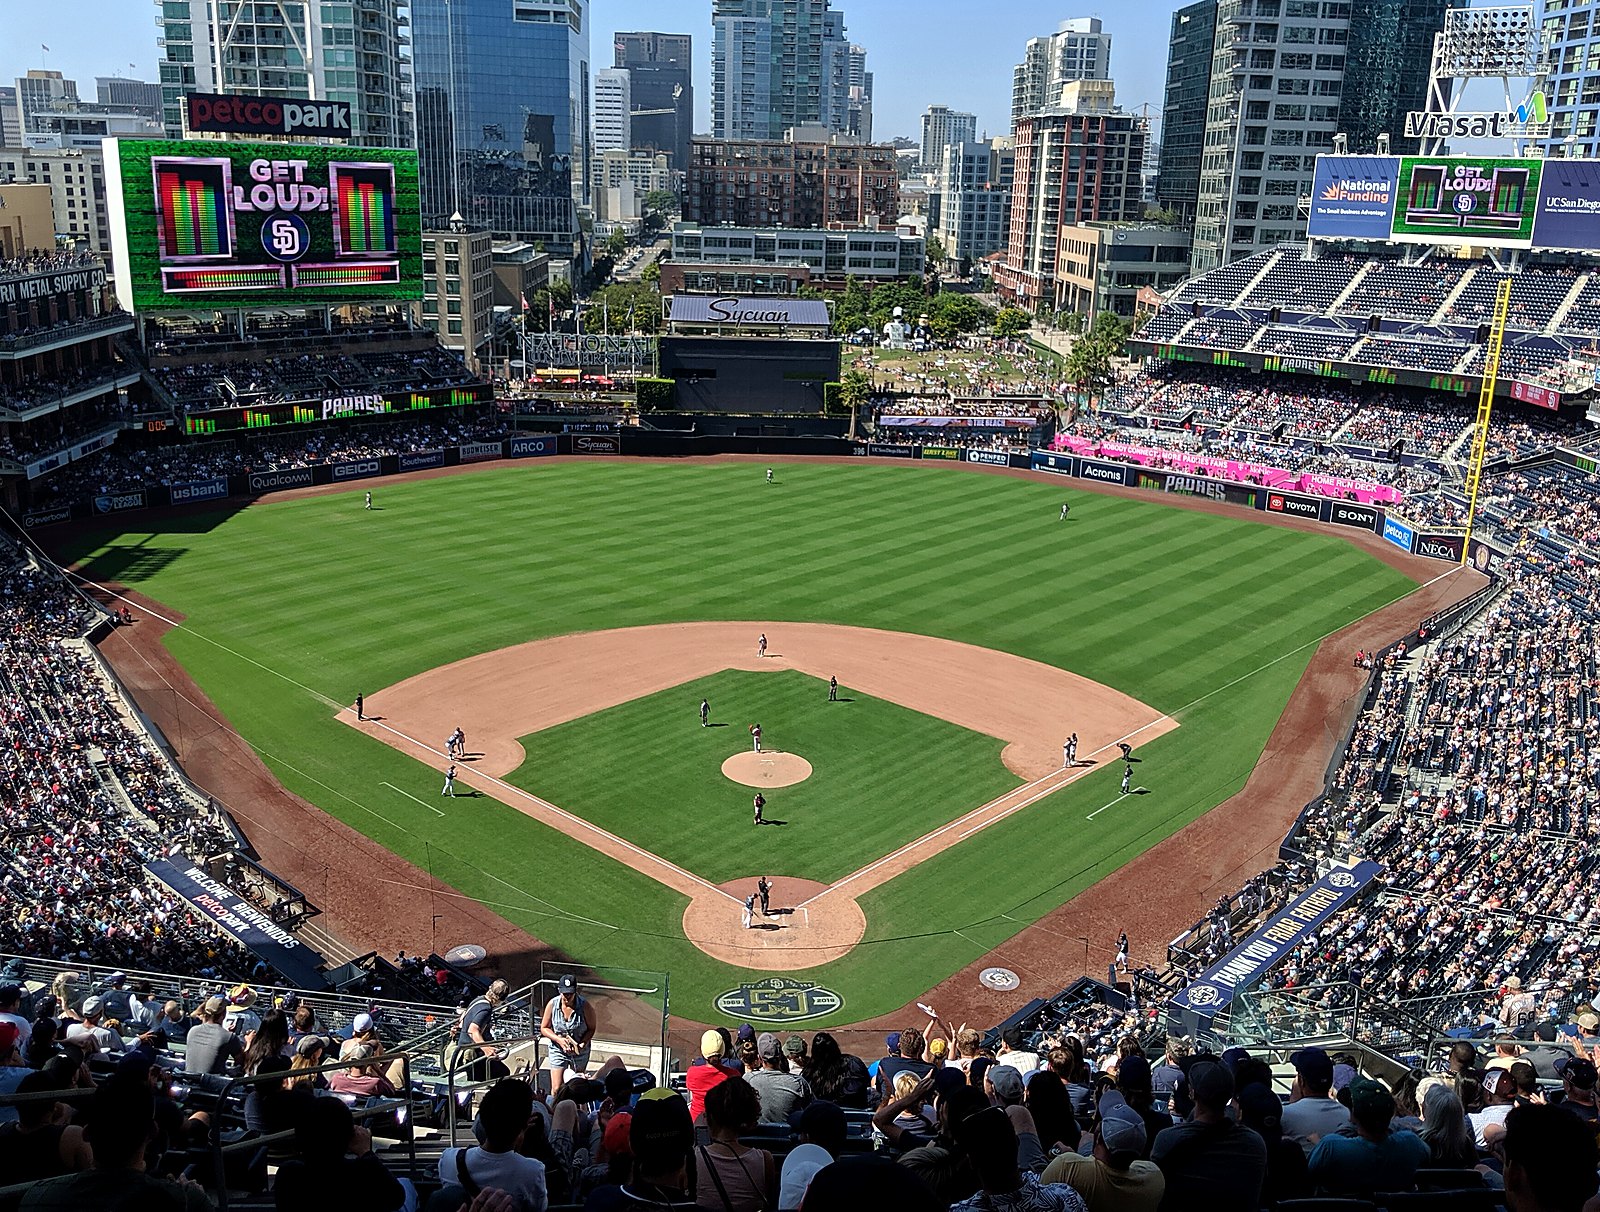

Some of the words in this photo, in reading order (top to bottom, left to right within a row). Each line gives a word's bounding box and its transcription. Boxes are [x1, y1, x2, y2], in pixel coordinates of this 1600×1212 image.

[1410, 112, 1503, 138] Viasat
[250, 159, 308, 182] GET
[1454, 165, 1484, 178] GET
[1340, 179, 1391, 192] National
[233, 183, 330, 211] LOUD!
[1339, 191, 1389, 203] Funding
[1560, 197, 1576, 208] San
[1576, 197, 1600, 210] Diego
[1360, 209, 1387, 217] Advantage
[19, 278, 53, 300] METAL
[53, 271, 89, 293] SUPPLY
[90, 269, 107, 286] CO.
[707, 297, 791, 328] Sycuan
[516, 331, 656, 354] NATIONAL
[528, 350, 647, 366] UNIVERSITY
[1282, 358, 1320, 371] PADRES
[322, 394, 385, 420] PADRES
[462, 443, 499, 456] BUDWEISER
[512, 441, 545, 454] ARCO
[577, 437, 613, 451] Sycuan
[853, 446, 866, 456] 396
[402, 455, 437, 467] Southwest
[979, 452, 1007, 462] PENFED
[1103, 442, 1127, 453] NOBODY
[1161, 451, 1181, 462] MORE
[1208, 459, 1228, 469] FANS
[334, 461, 379, 477] GEICO
[1084, 465, 1121, 481] Acronis
[252, 473, 311, 489] Qualcomm
[1164, 475, 1227, 501] PADRES
[1311, 475, 1334, 487] HOME
[1354, 481, 1378, 493] DECK
[113, 493, 143, 504] ROCKET
[113, 499, 143, 509] LEAGUE
[1285, 500, 1317, 513] TOYOTA
[34, 511, 69, 524] everbowl
[1337, 509, 1375, 524] SONY
[1384, 522, 1403, 540] petco
[1419, 541, 1456, 560] NECA
[184, 866, 233, 901] WELCOME
[232, 902, 300, 950] BIENVENIDOS
[1209, 954, 1262, 988] THANK
[1240, 939, 1279, 961] YOU
[1263, 917, 1306, 946] FRIAR
[1289, 886, 1344, 923] FAITHFUL
